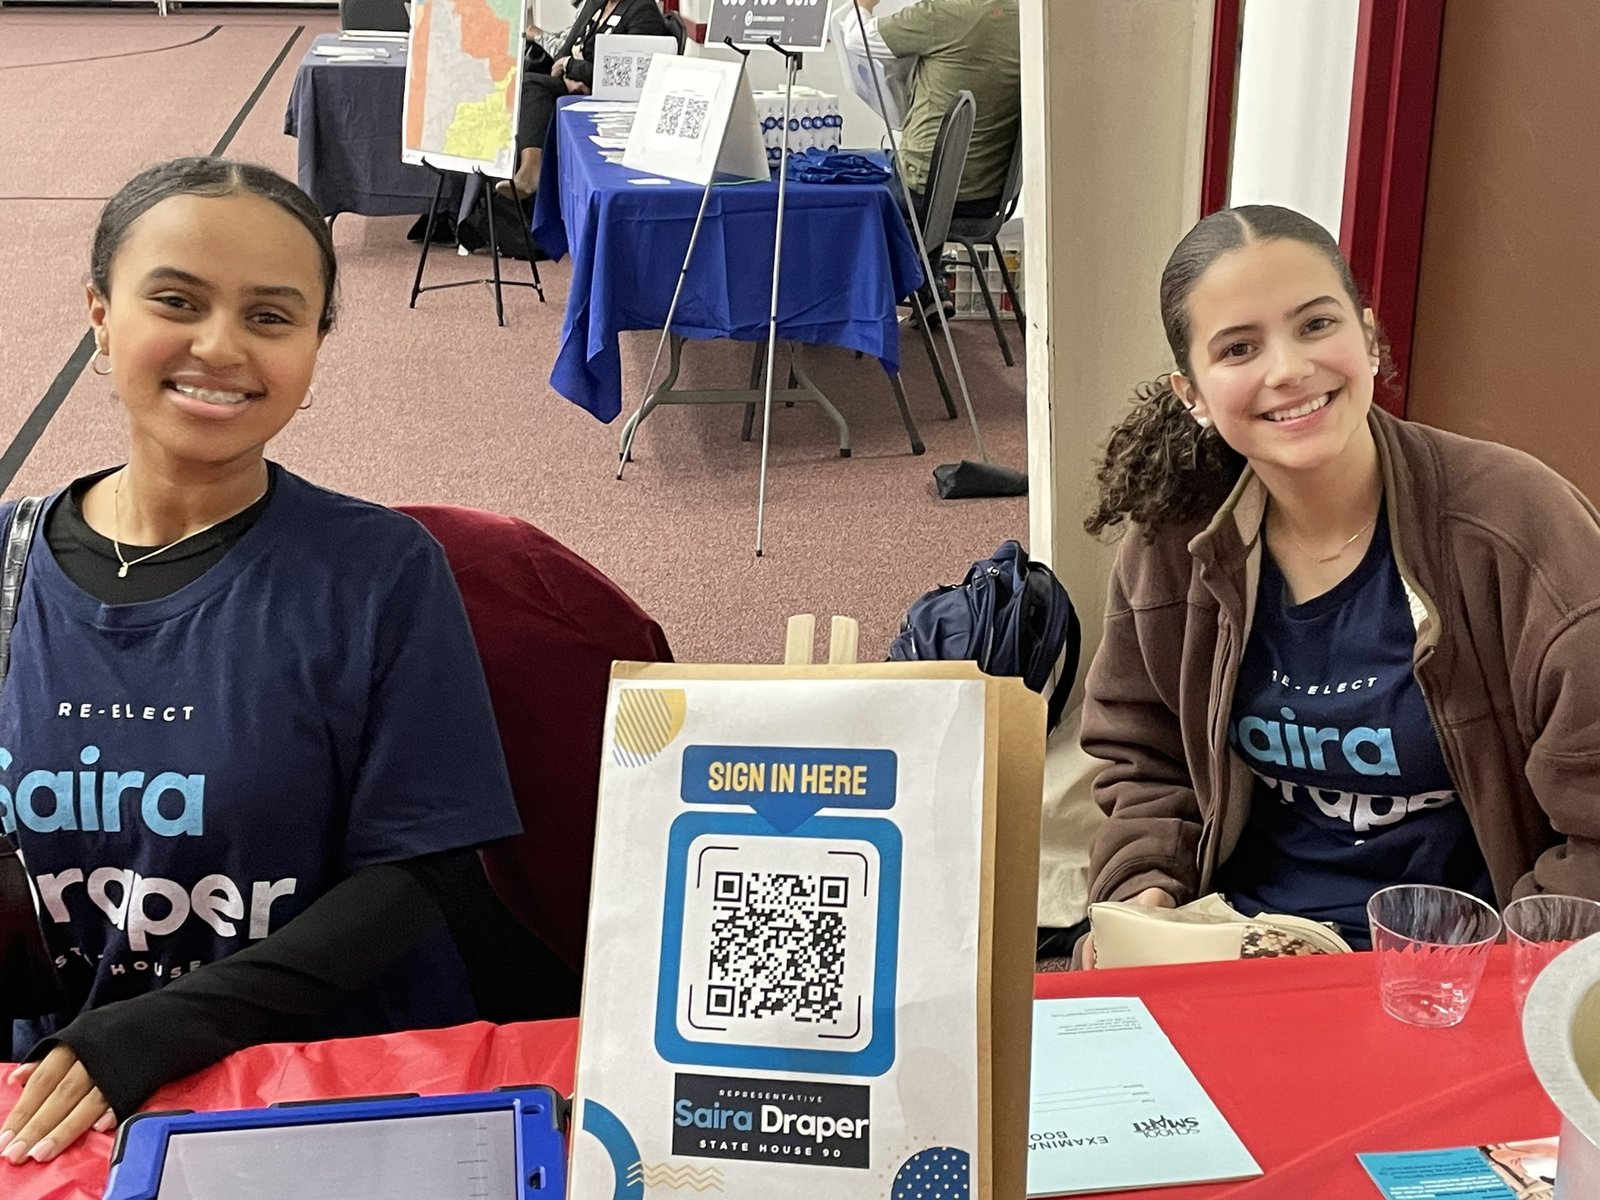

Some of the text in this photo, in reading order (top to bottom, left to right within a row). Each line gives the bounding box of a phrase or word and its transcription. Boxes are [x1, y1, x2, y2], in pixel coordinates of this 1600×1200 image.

[58, 702, 194, 721] RE-ELECT
[1229, 706, 1401, 776] aira
[708, 761, 867, 795] SIGN IN HERE
[16, 848, 297, 952] raper
[719, 1089, 823, 1103] REPRESENTATIVE
[674, 1099, 870, 1144] Saira Draper
[1132, 1115, 1199, 1133] SMART
[1142, 1125, 1200, 1139] SCHOOL
[699, 1139, 842, 1158] STATE HOUSE 90
